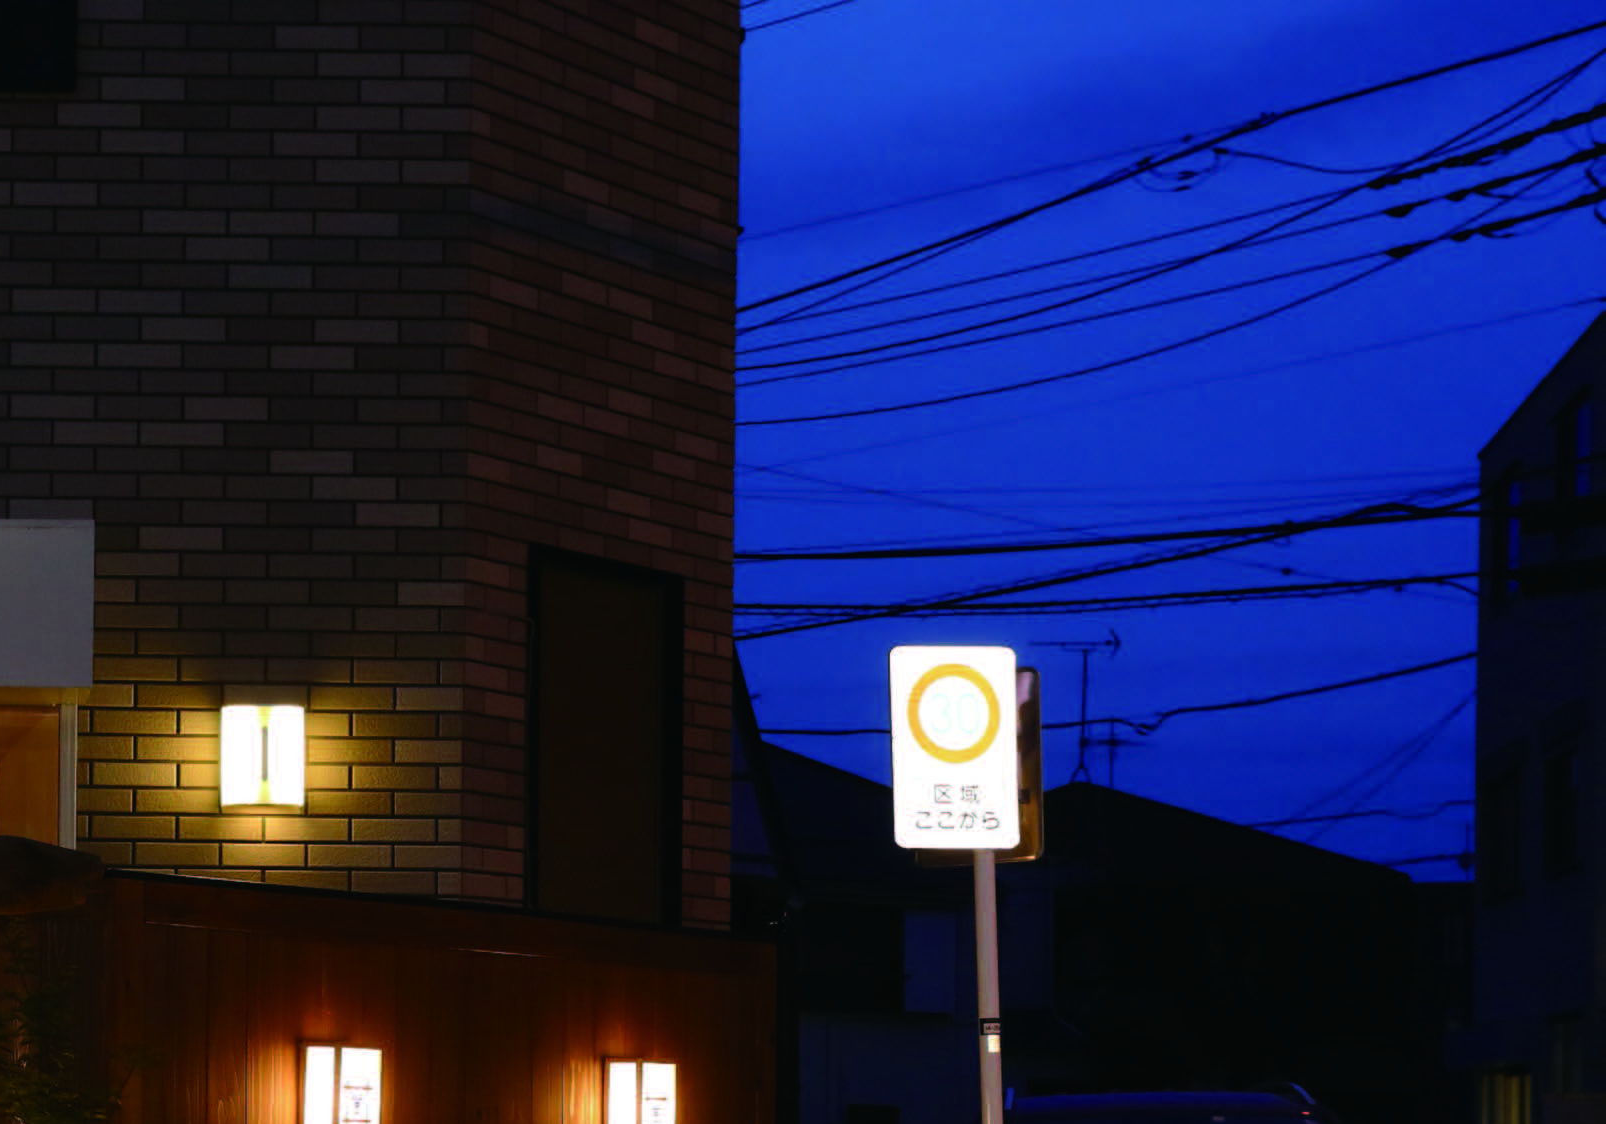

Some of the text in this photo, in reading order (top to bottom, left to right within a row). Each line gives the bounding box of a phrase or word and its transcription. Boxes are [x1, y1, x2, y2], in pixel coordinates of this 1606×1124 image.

[932, 692, 980, 734] 30
[934, 784, 980, 804] 区域
[915, 811, 1000, 830] ここから
